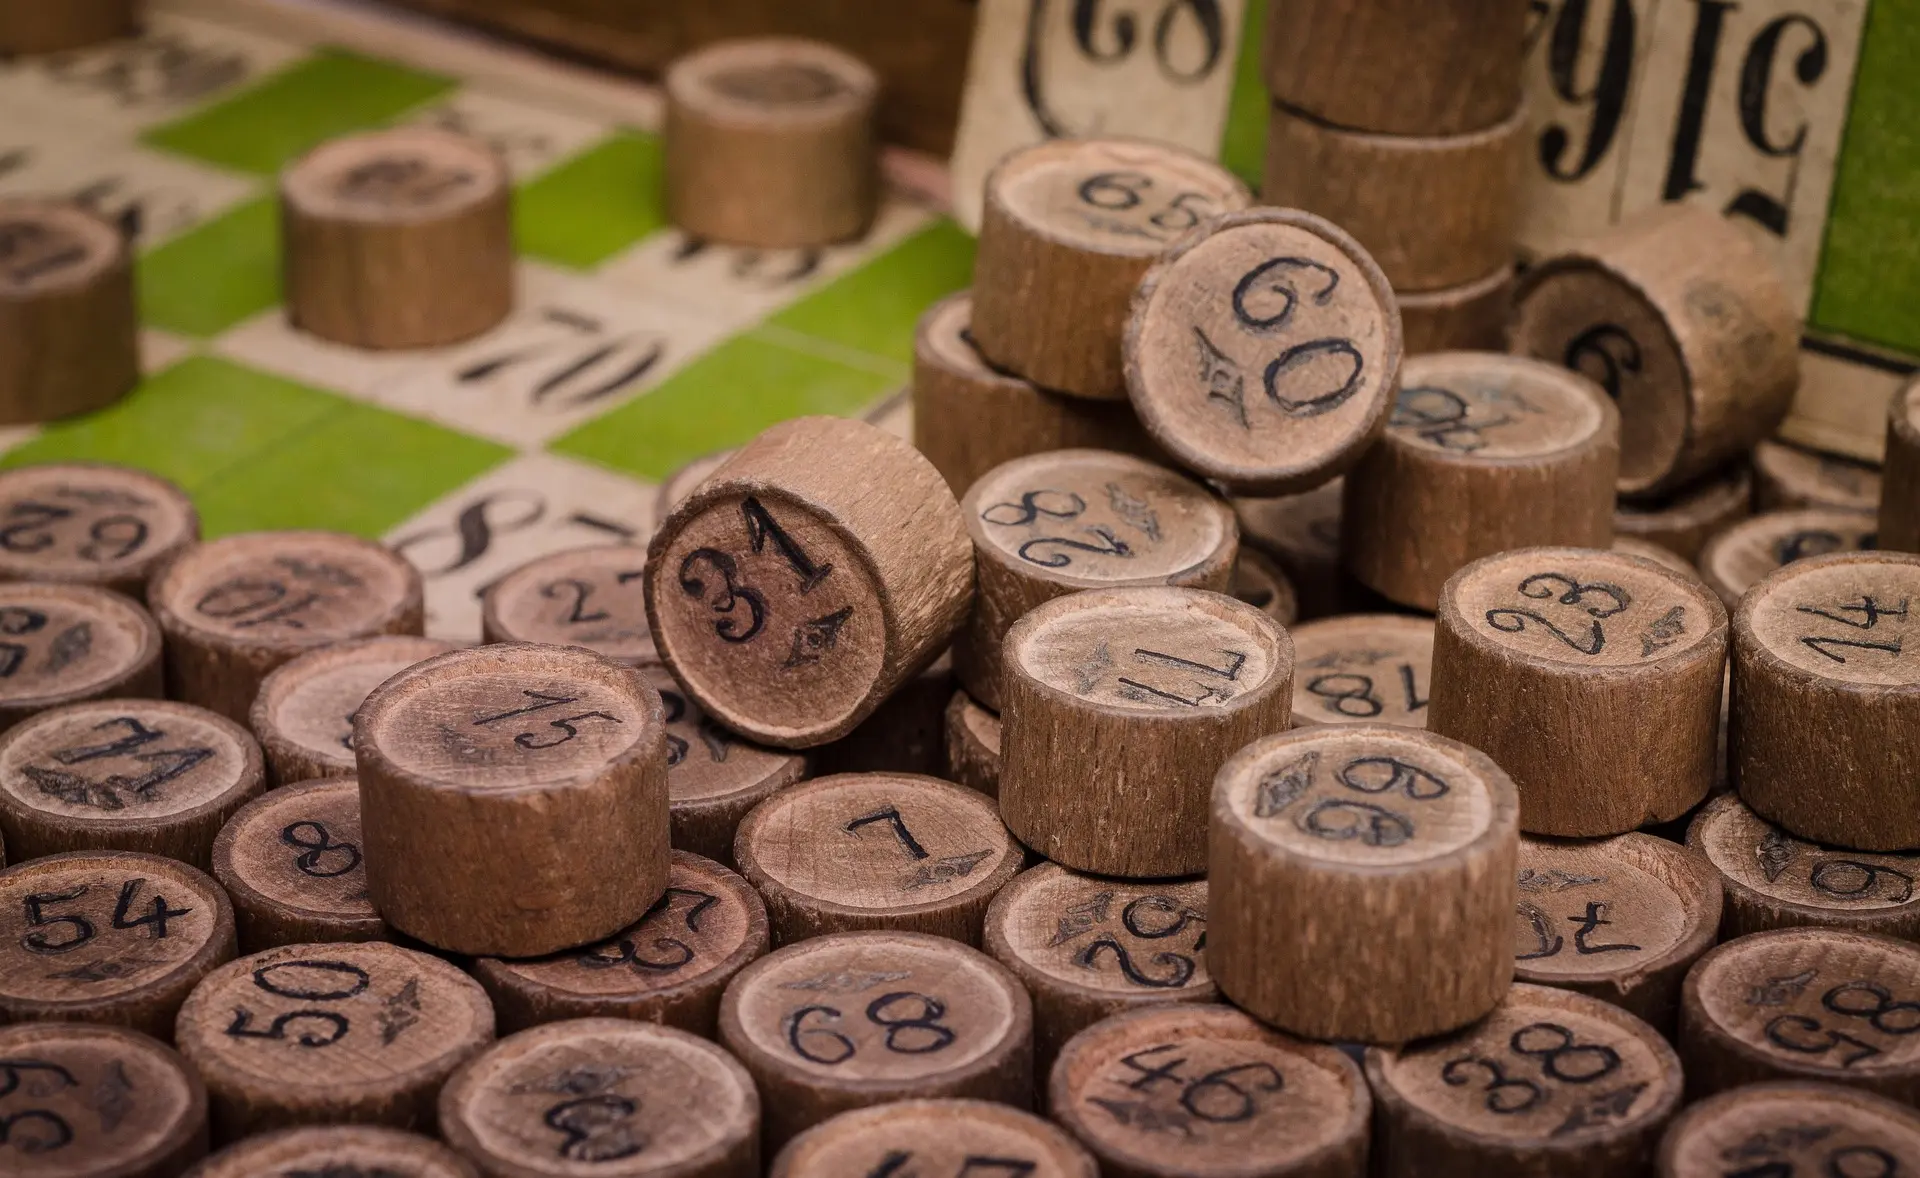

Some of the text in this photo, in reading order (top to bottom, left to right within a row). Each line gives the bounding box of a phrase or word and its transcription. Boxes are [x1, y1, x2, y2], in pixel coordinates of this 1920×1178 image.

[1522, 0, 1636, 183] 6
[1080, 172, 1208, 230] 65
[1231, 255, 1366, 417] 60
[981, 488, 1136, 568] 28
[538, 570, 643, 624] 2
[678, 495, 834, 644] 31
[1485, 571, 1632, 656] 23
[472, 689, 623, 750] 15
[281, 819, 363, 878] 8
[845, 806, 929, 860] 7
[21, 877, 194, 954] 54
[223, 959, 371, 1048] 50
[787, 990, 956, 1065] 68
[1119, 1043, 1285, 1124] 46
[1441, 1022, 1623, 1114] 38
